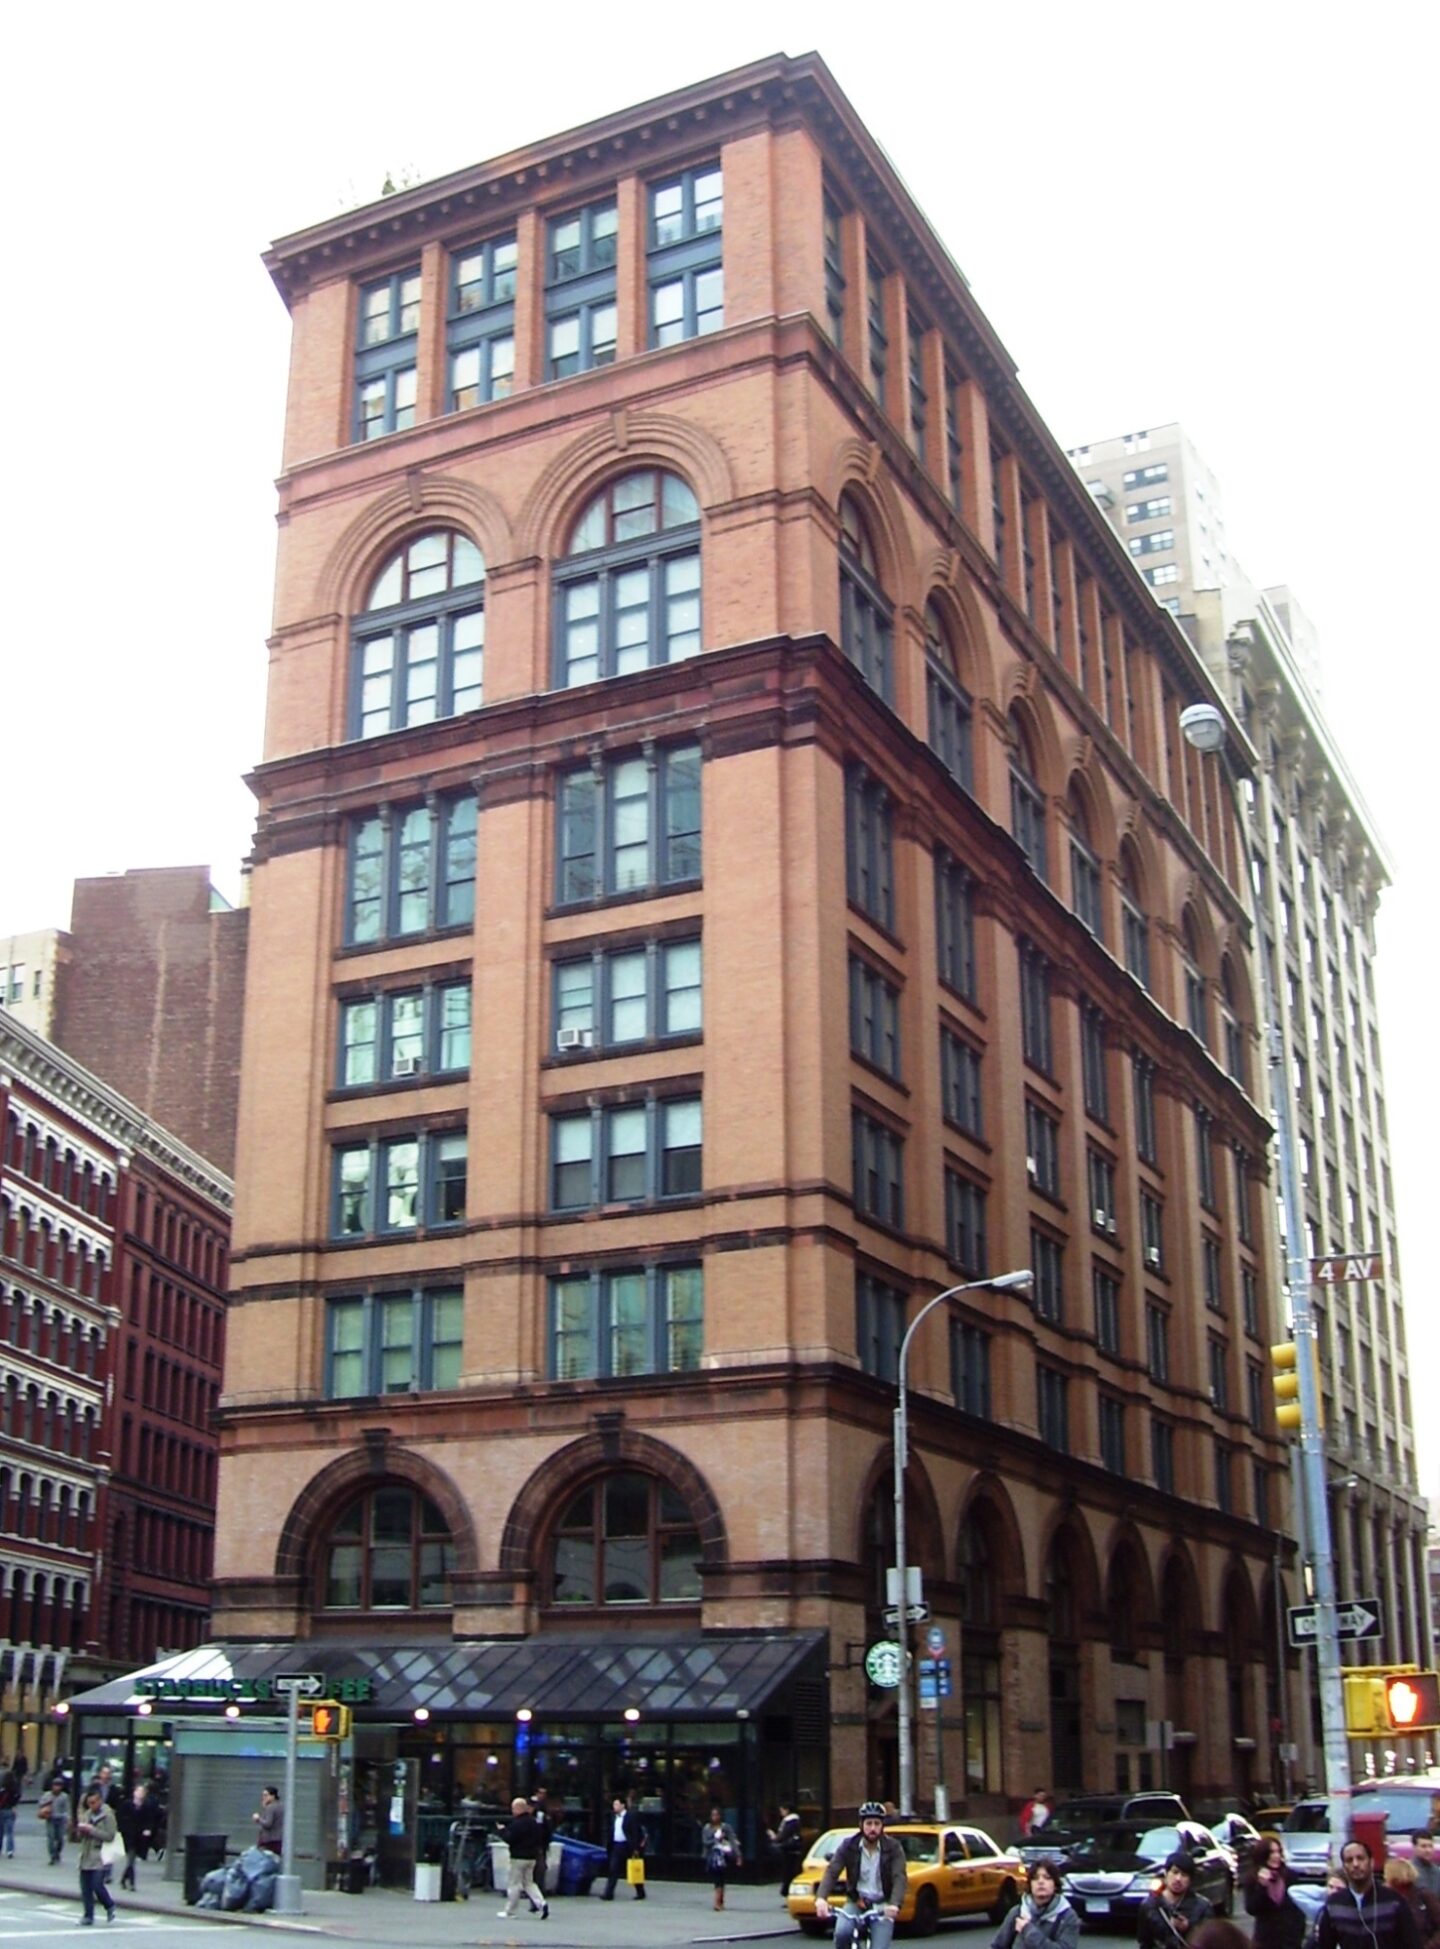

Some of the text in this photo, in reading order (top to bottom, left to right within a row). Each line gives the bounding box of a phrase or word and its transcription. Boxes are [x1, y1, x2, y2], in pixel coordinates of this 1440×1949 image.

[1317, 1258, 1373, 1281] 4 AV
[134, 1678, 272, 1698] STARBUCKS
